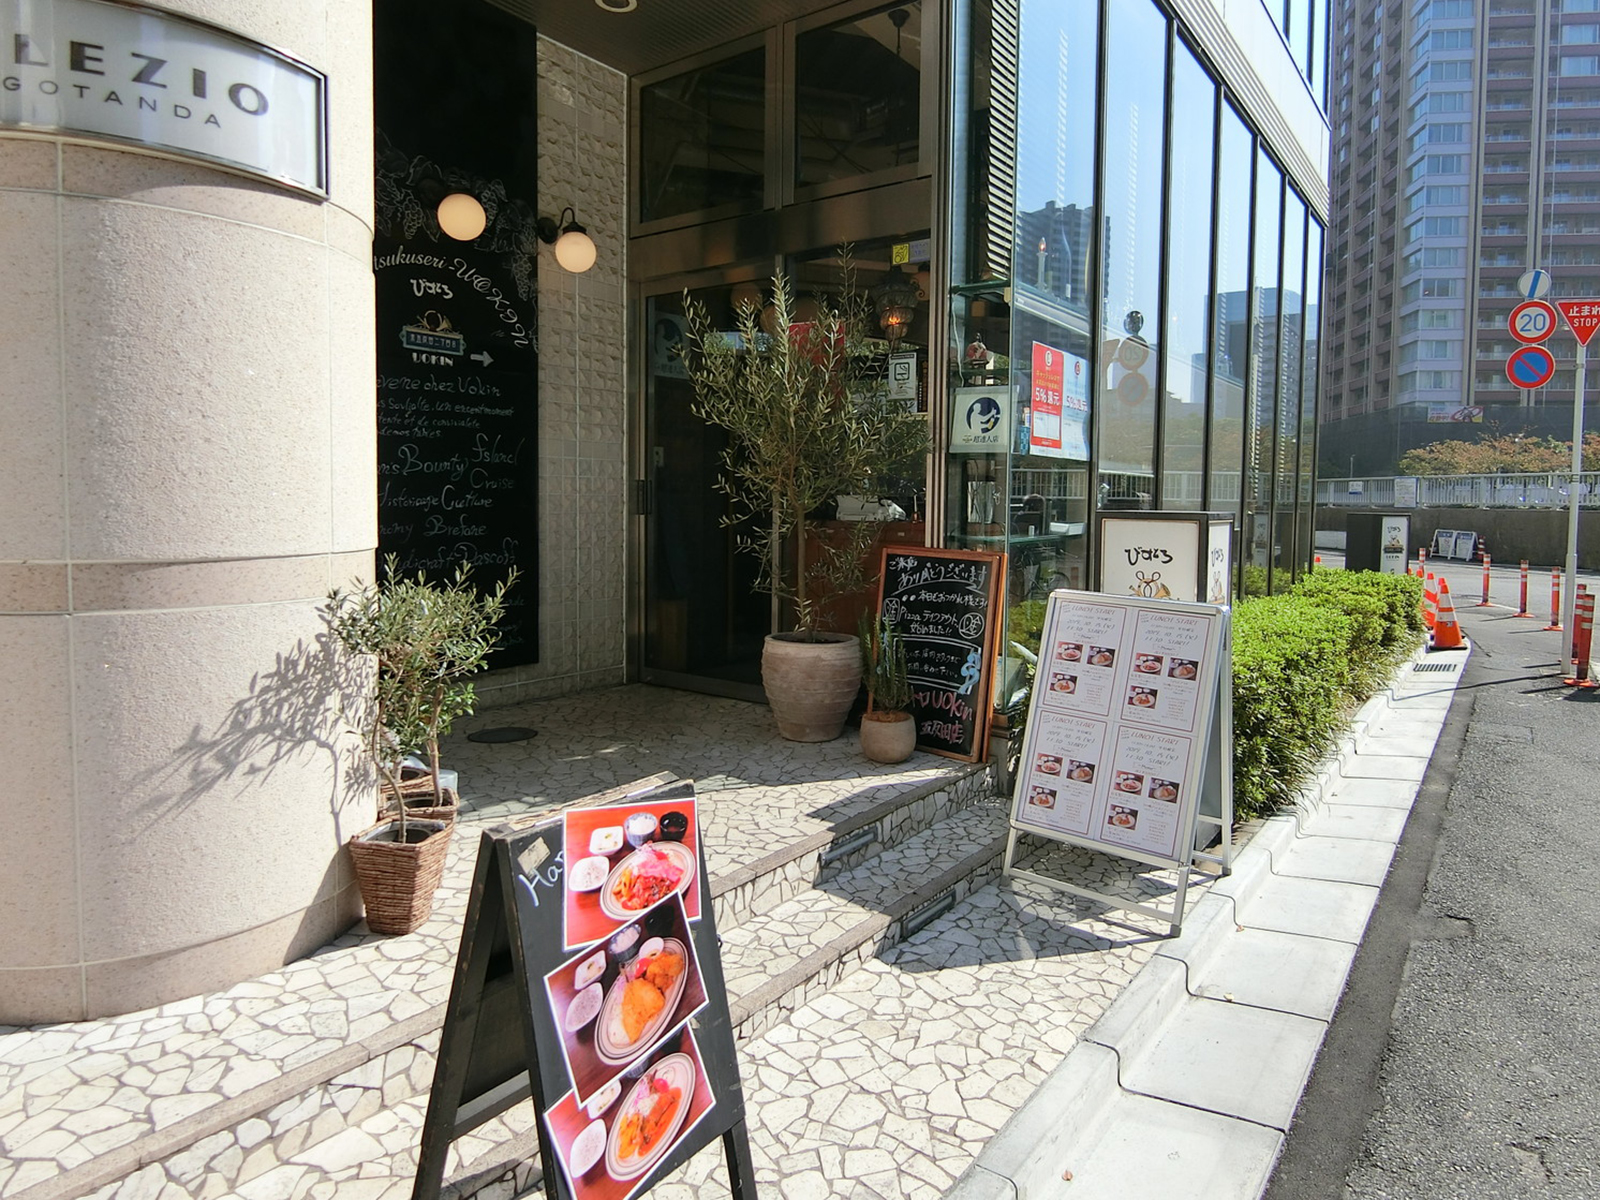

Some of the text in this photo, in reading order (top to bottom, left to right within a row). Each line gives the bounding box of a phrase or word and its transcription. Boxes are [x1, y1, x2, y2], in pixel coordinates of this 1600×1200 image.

[14, 33, 269, 117] LEZIO
[2, 76, 222, 129] GOTANDA
[1520, 313, 1546, 332] 20
[1573, 318, 1598, 327] STOP
[412, 352, 454, 367] UOKIN
[1124, 546, 1173, 566] びすとろ
[920, 720, 965, 744] 五反田店
